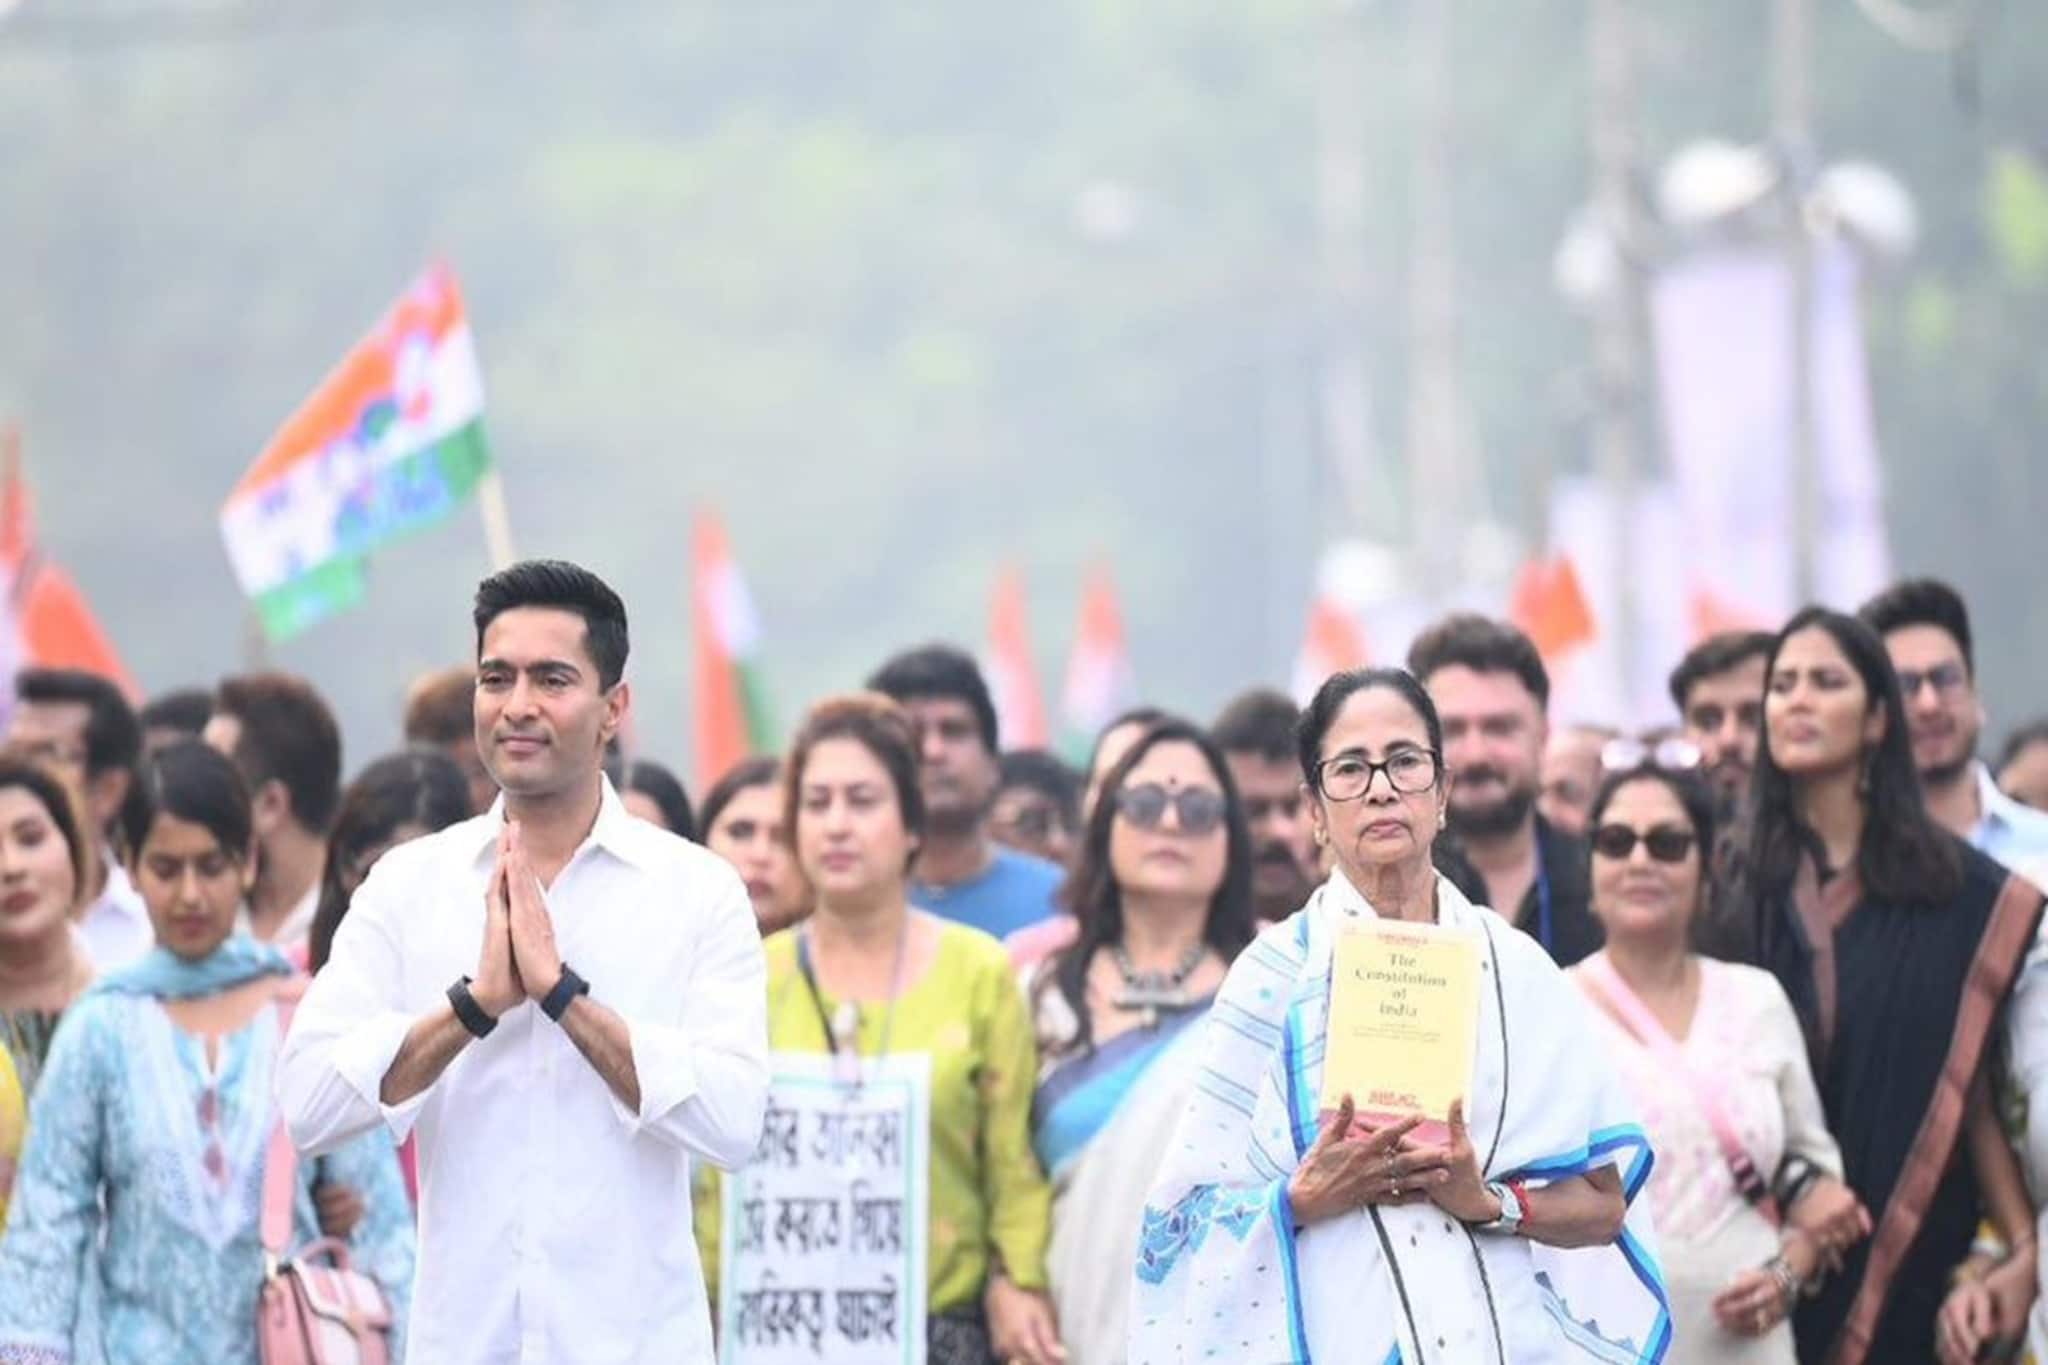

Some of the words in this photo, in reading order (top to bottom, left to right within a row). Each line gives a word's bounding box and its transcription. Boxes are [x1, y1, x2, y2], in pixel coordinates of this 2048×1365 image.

[1390, 953, 1417, 967] The
[1355, 968, 1447, 987] Constitution
[1392, 987, 1407, 1000] of
[1379, 1001, 1417, 1017] India
